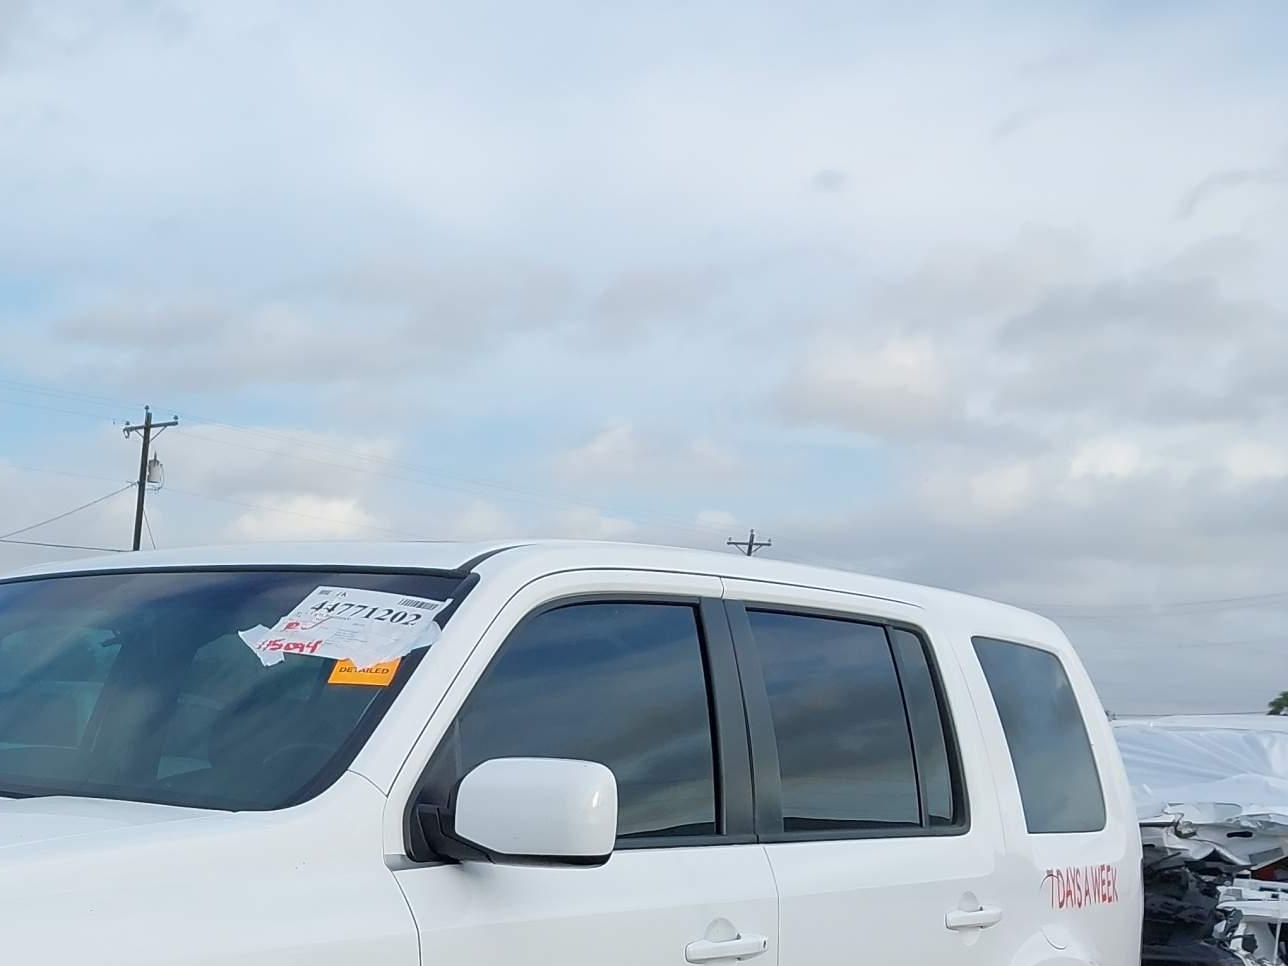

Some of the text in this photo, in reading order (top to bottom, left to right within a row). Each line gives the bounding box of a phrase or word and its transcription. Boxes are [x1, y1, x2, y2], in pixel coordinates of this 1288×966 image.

[312, 600, 422, 626] 44771202
[1055, 866, 1083, 909] DAYS
[1083, 865, 1092, 907] A
[1091, 863, 1119, 903] WEEK
